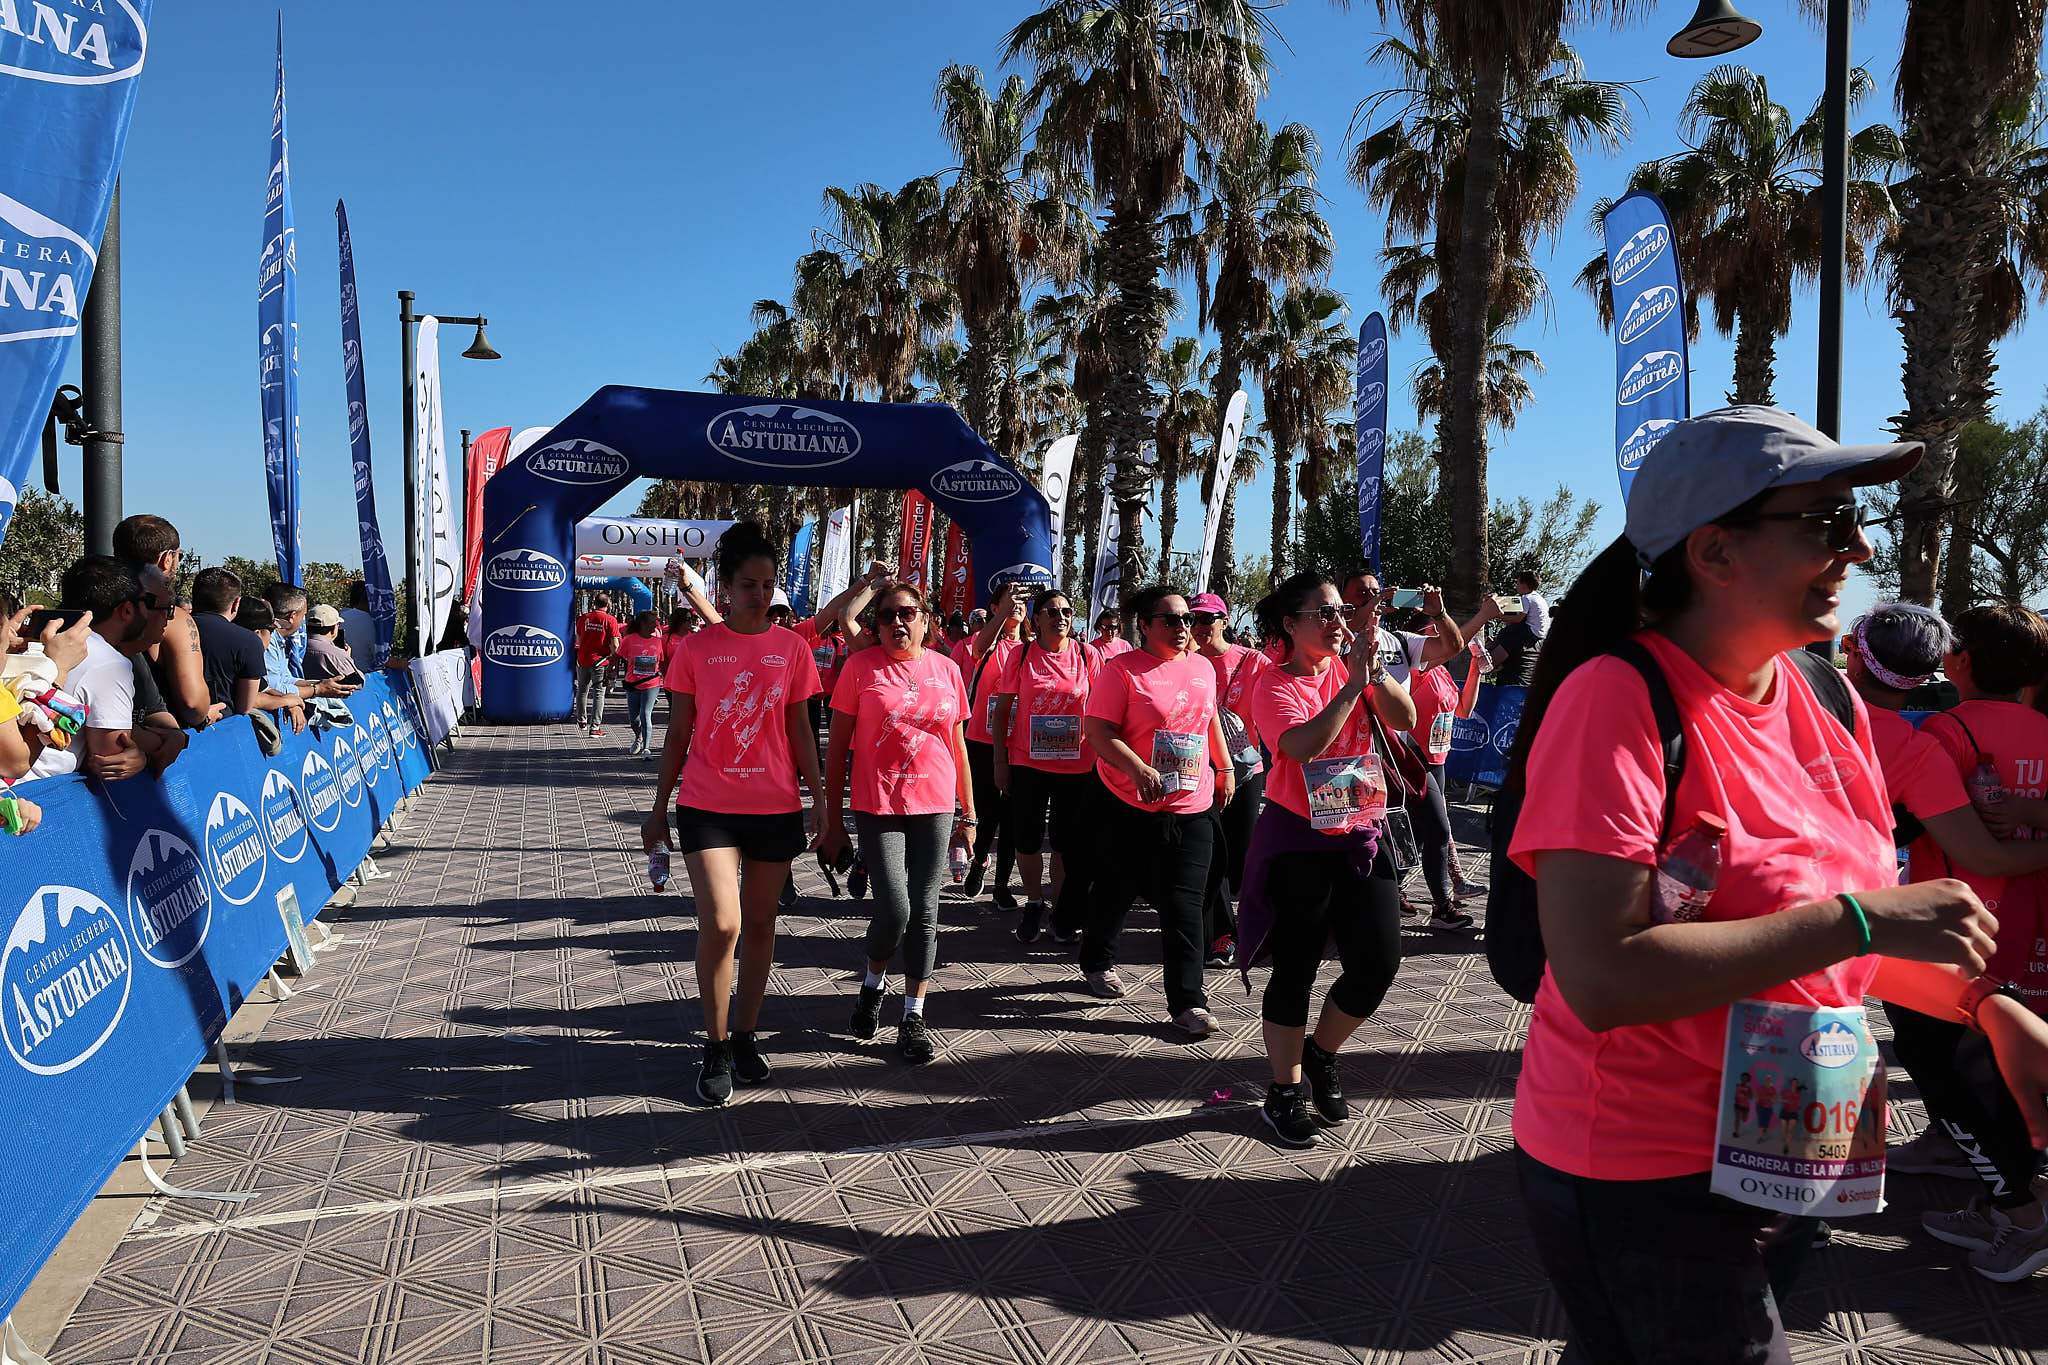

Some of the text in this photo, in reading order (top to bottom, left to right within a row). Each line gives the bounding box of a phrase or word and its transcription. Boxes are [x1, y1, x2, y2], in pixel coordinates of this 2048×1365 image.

[719, 420, 851, 455] ASTURIANA
[742, 420, 846, 433] CENTRAL LECHERA
[532, 454, 622, 476] ASTURIANA
[939, 475, 1017, 492] ASTURIANA
[602, 525, 705, 547] OYSHO
[910, 501, 925, 568] Santander
[489, 563, 561, 582] ASTURIANA
[488, 639, 559, 657] ASTURIANA
[707, 655, 737, 665] OYSHO
[2015, 759, 2044, 785] TU
[266, 806, 307, 848] ASTURIANA
[212, 832, 265, 889] ASTURIANA
[136, 874, 209, 952] ASTURIANA
[26, 917, 110, 984] CENTRAL LECHERA
[12, 937, 128, 1057] ASTURIANA
[1806, 1037, 1857, 1057] ASTURIANA
[1804, 1100, 1857, 1135] 016
[1729, 1151, 1790, 1173] CARRERA
[1794, 1163, 1810, 1176] DE
[1812, 1164, 1826, 1176] LA
[1817, 1143, 1848, 1159] 5403
[1740, 1177, 1816, 1203] OYSHO
